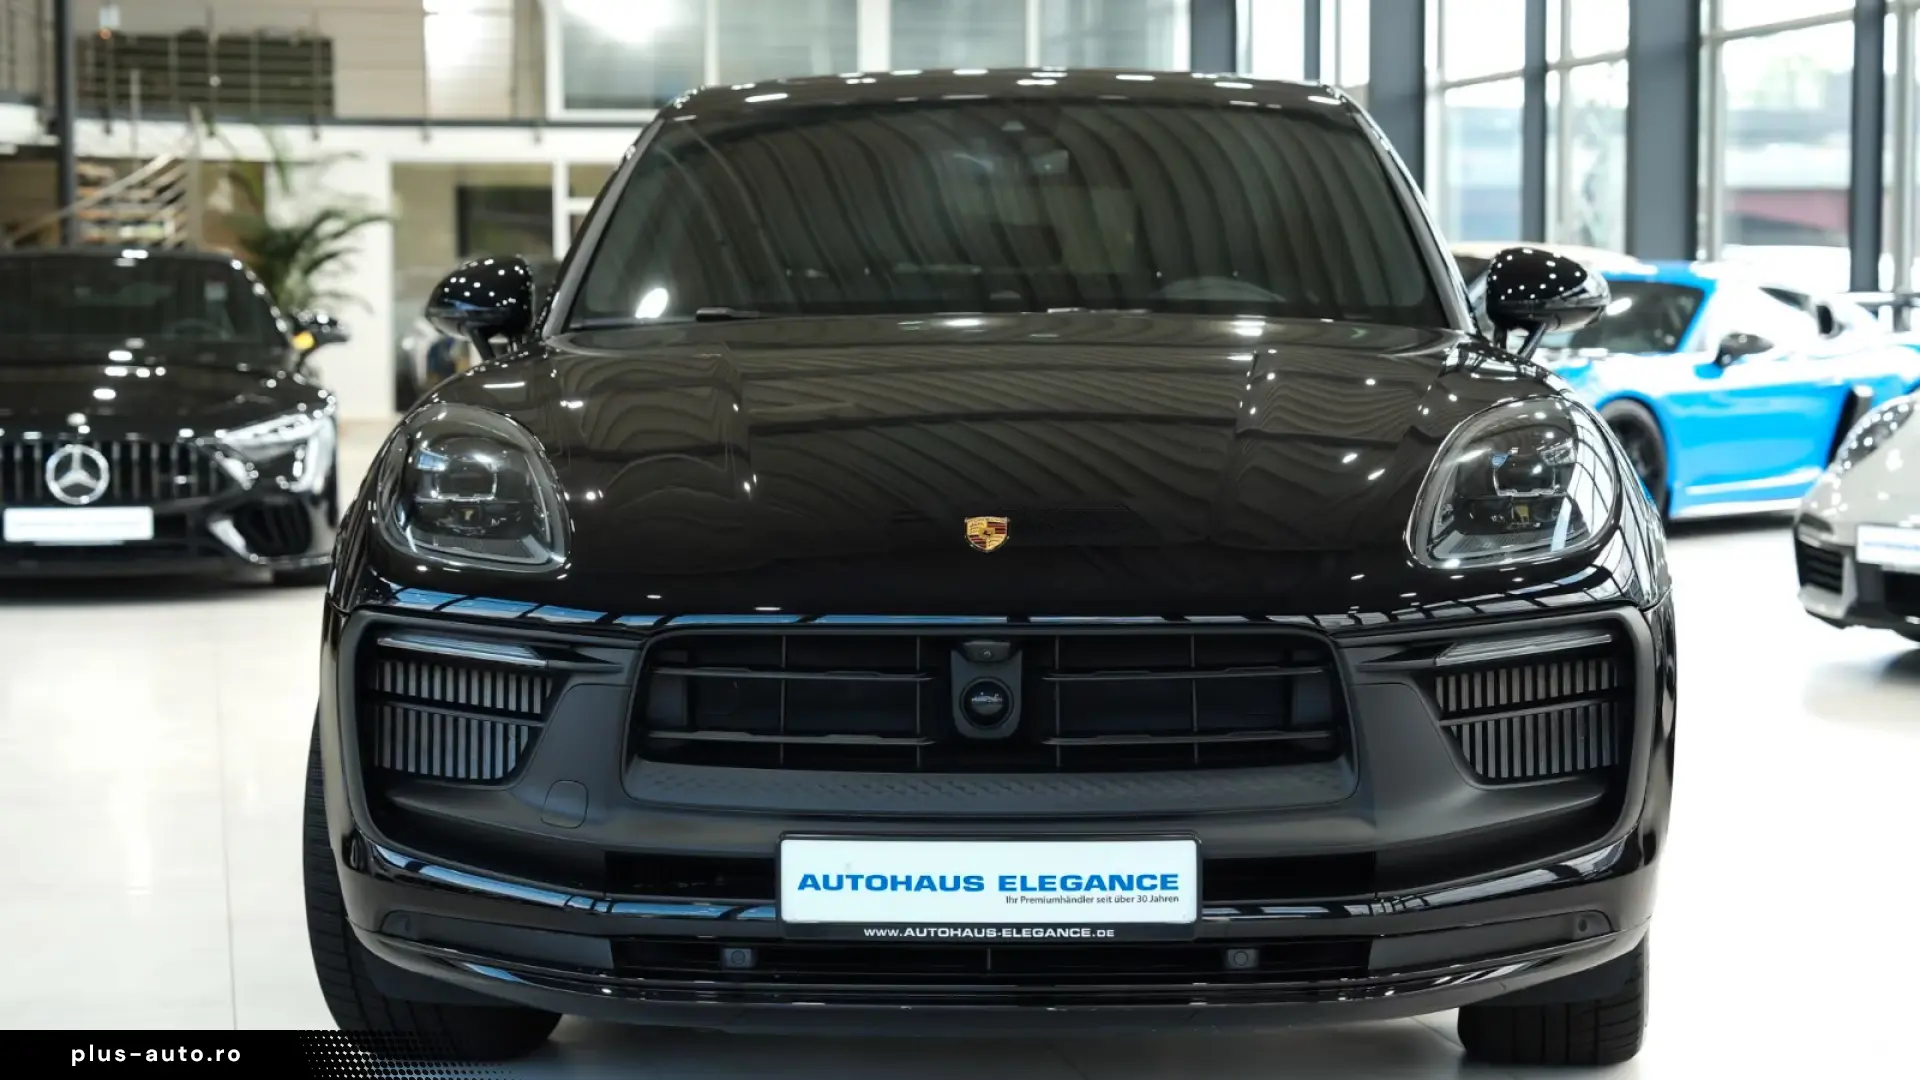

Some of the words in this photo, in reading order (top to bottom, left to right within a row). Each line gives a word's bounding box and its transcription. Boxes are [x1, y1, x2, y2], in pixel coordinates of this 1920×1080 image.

[797, 874, 985, 892] AUTOHAUS
[998, 873, 1179, 892] ELEGANCE
[1005, 895, 1018, 905] Ihr
[1020, 895, 1094, 905] Premiumhändler
[1096, 895, 1112, 904] seit
[1114, 894, 1135, 904] über
[1136, 895, 1147, 904] 30
[1149, 894, 1179, 904] Jahren
